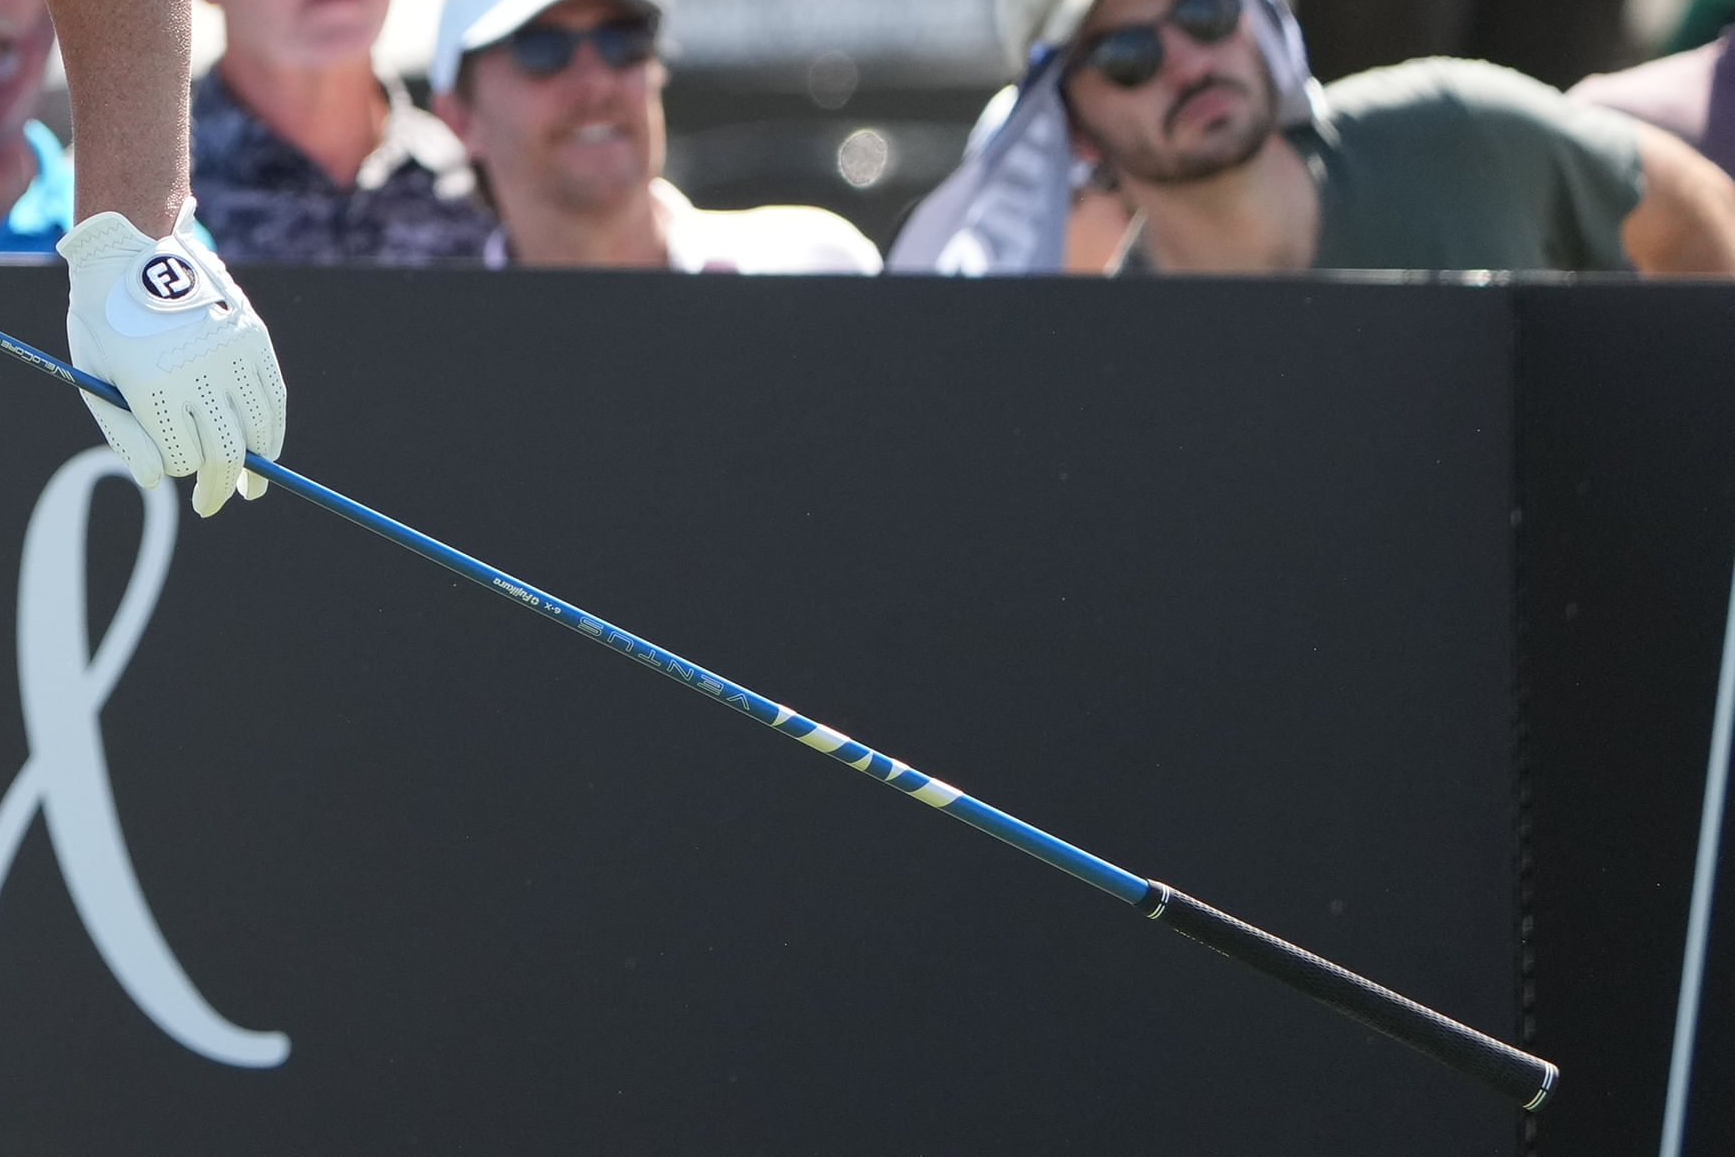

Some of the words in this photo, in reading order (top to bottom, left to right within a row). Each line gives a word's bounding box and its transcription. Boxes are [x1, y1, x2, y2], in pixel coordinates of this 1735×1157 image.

[146, 257, 191, 298] FJ
[493, 577, 533, 602] Fujikura
[578, 615, 751, 712] VENTUS
